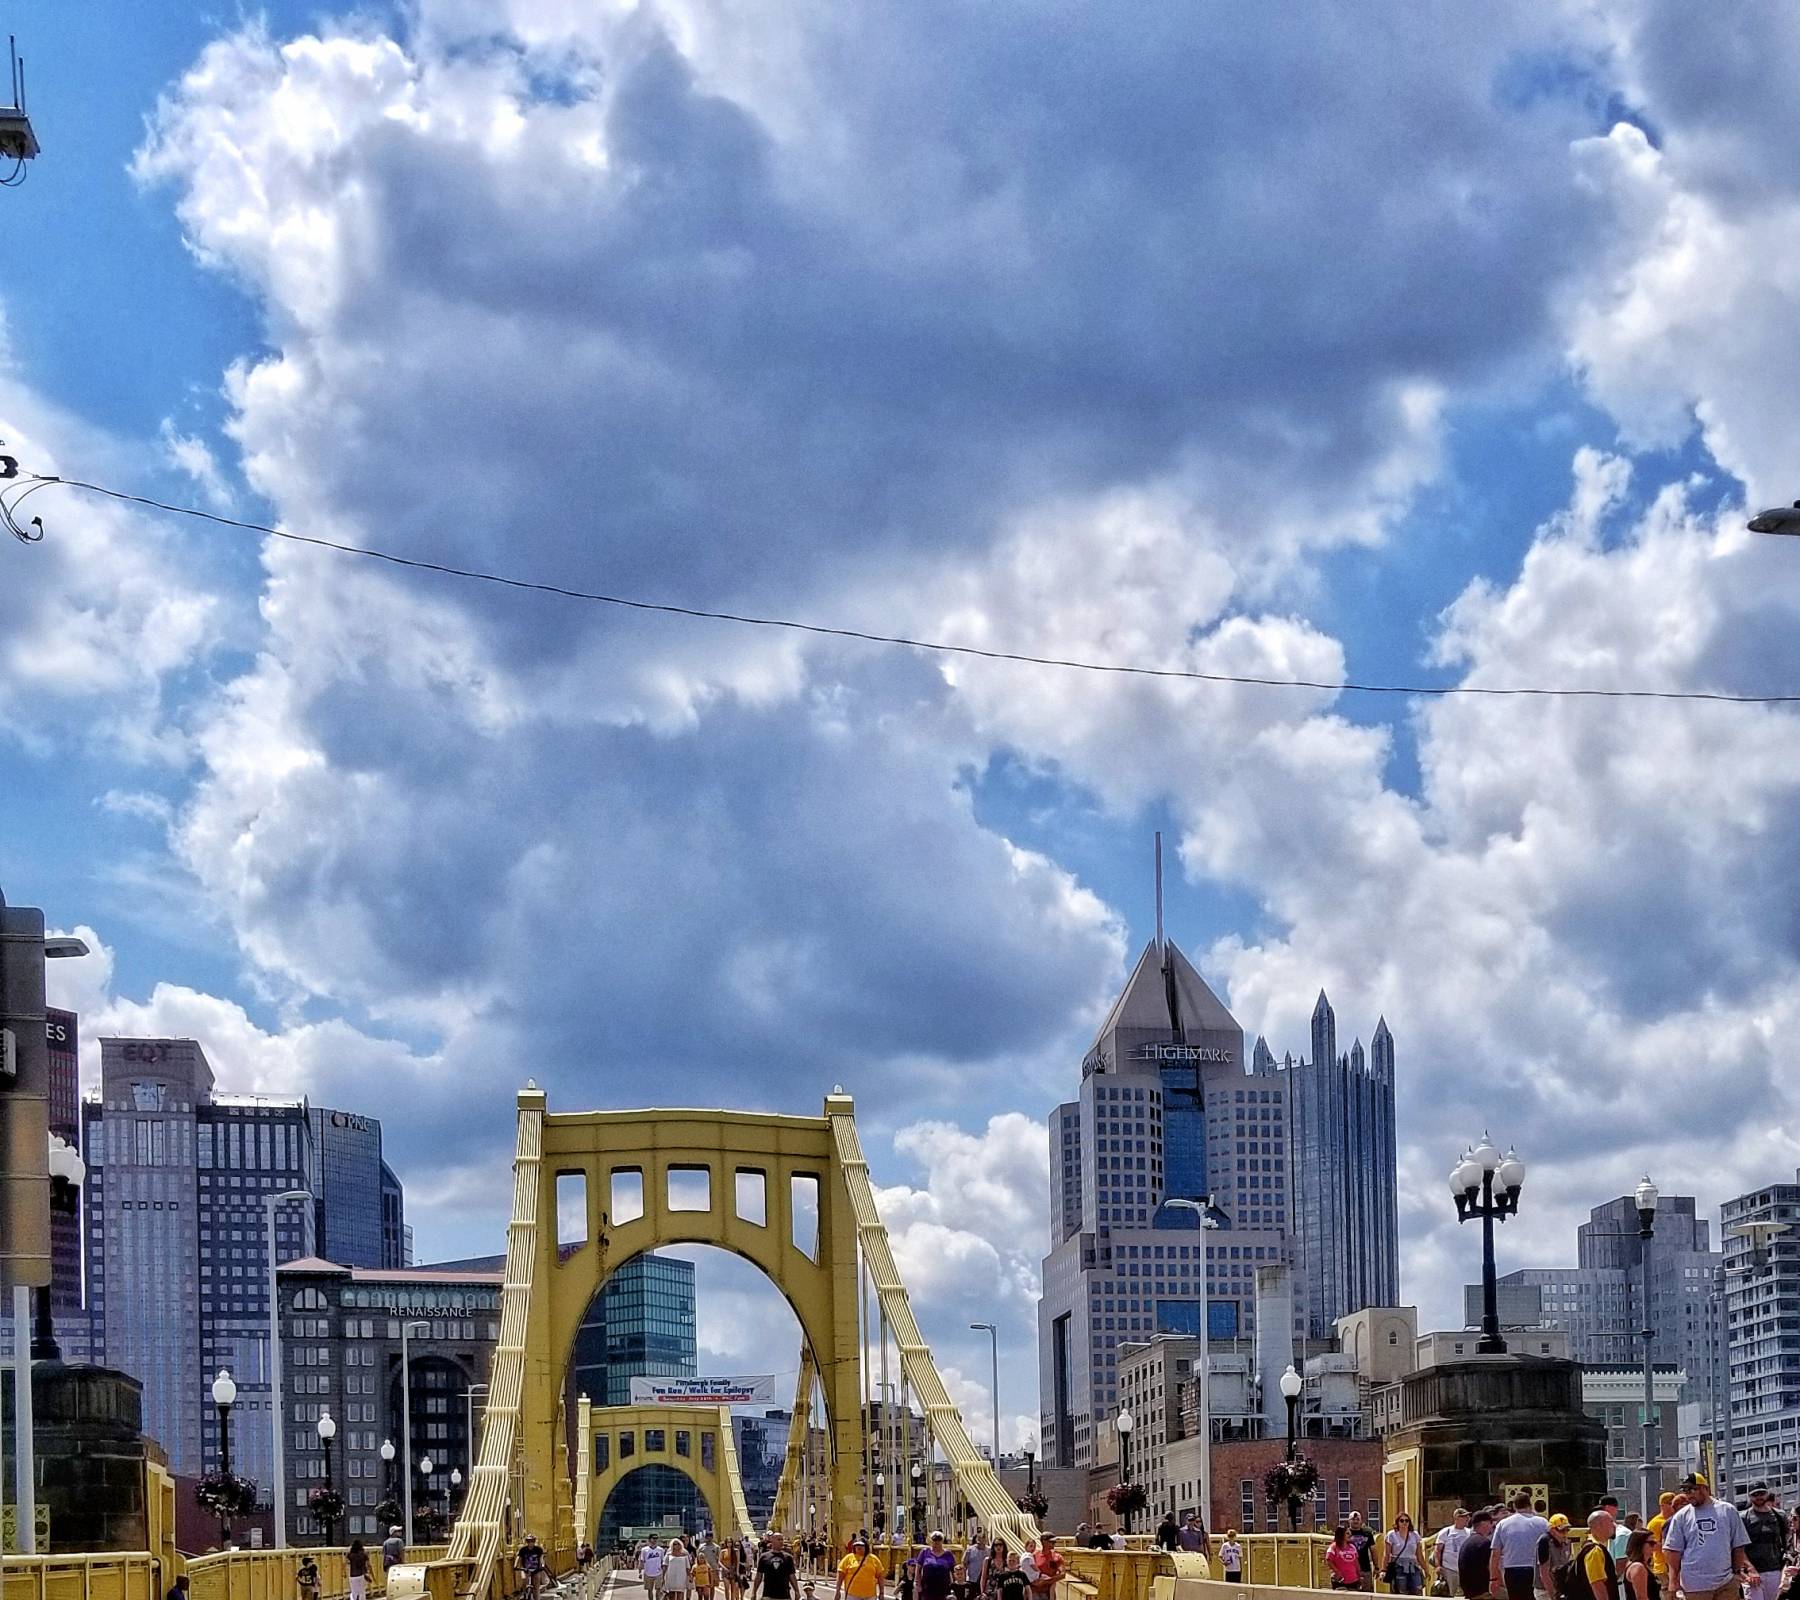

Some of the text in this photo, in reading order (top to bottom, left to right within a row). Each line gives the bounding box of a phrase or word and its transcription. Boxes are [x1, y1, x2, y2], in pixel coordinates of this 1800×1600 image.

[1145, 1043, 1230, 1064] HIGHMARK
[389, 1306, 473, 1318] RENAISSANCE
[710, 1379, 731, 1387] Family
[652, 1386, 666, 1394] Fun
[689, 1385, 709, 1394] Walk
[710, 1386, 721, 1394] for
[723, 1386, 755, 1395] Epilepsy
